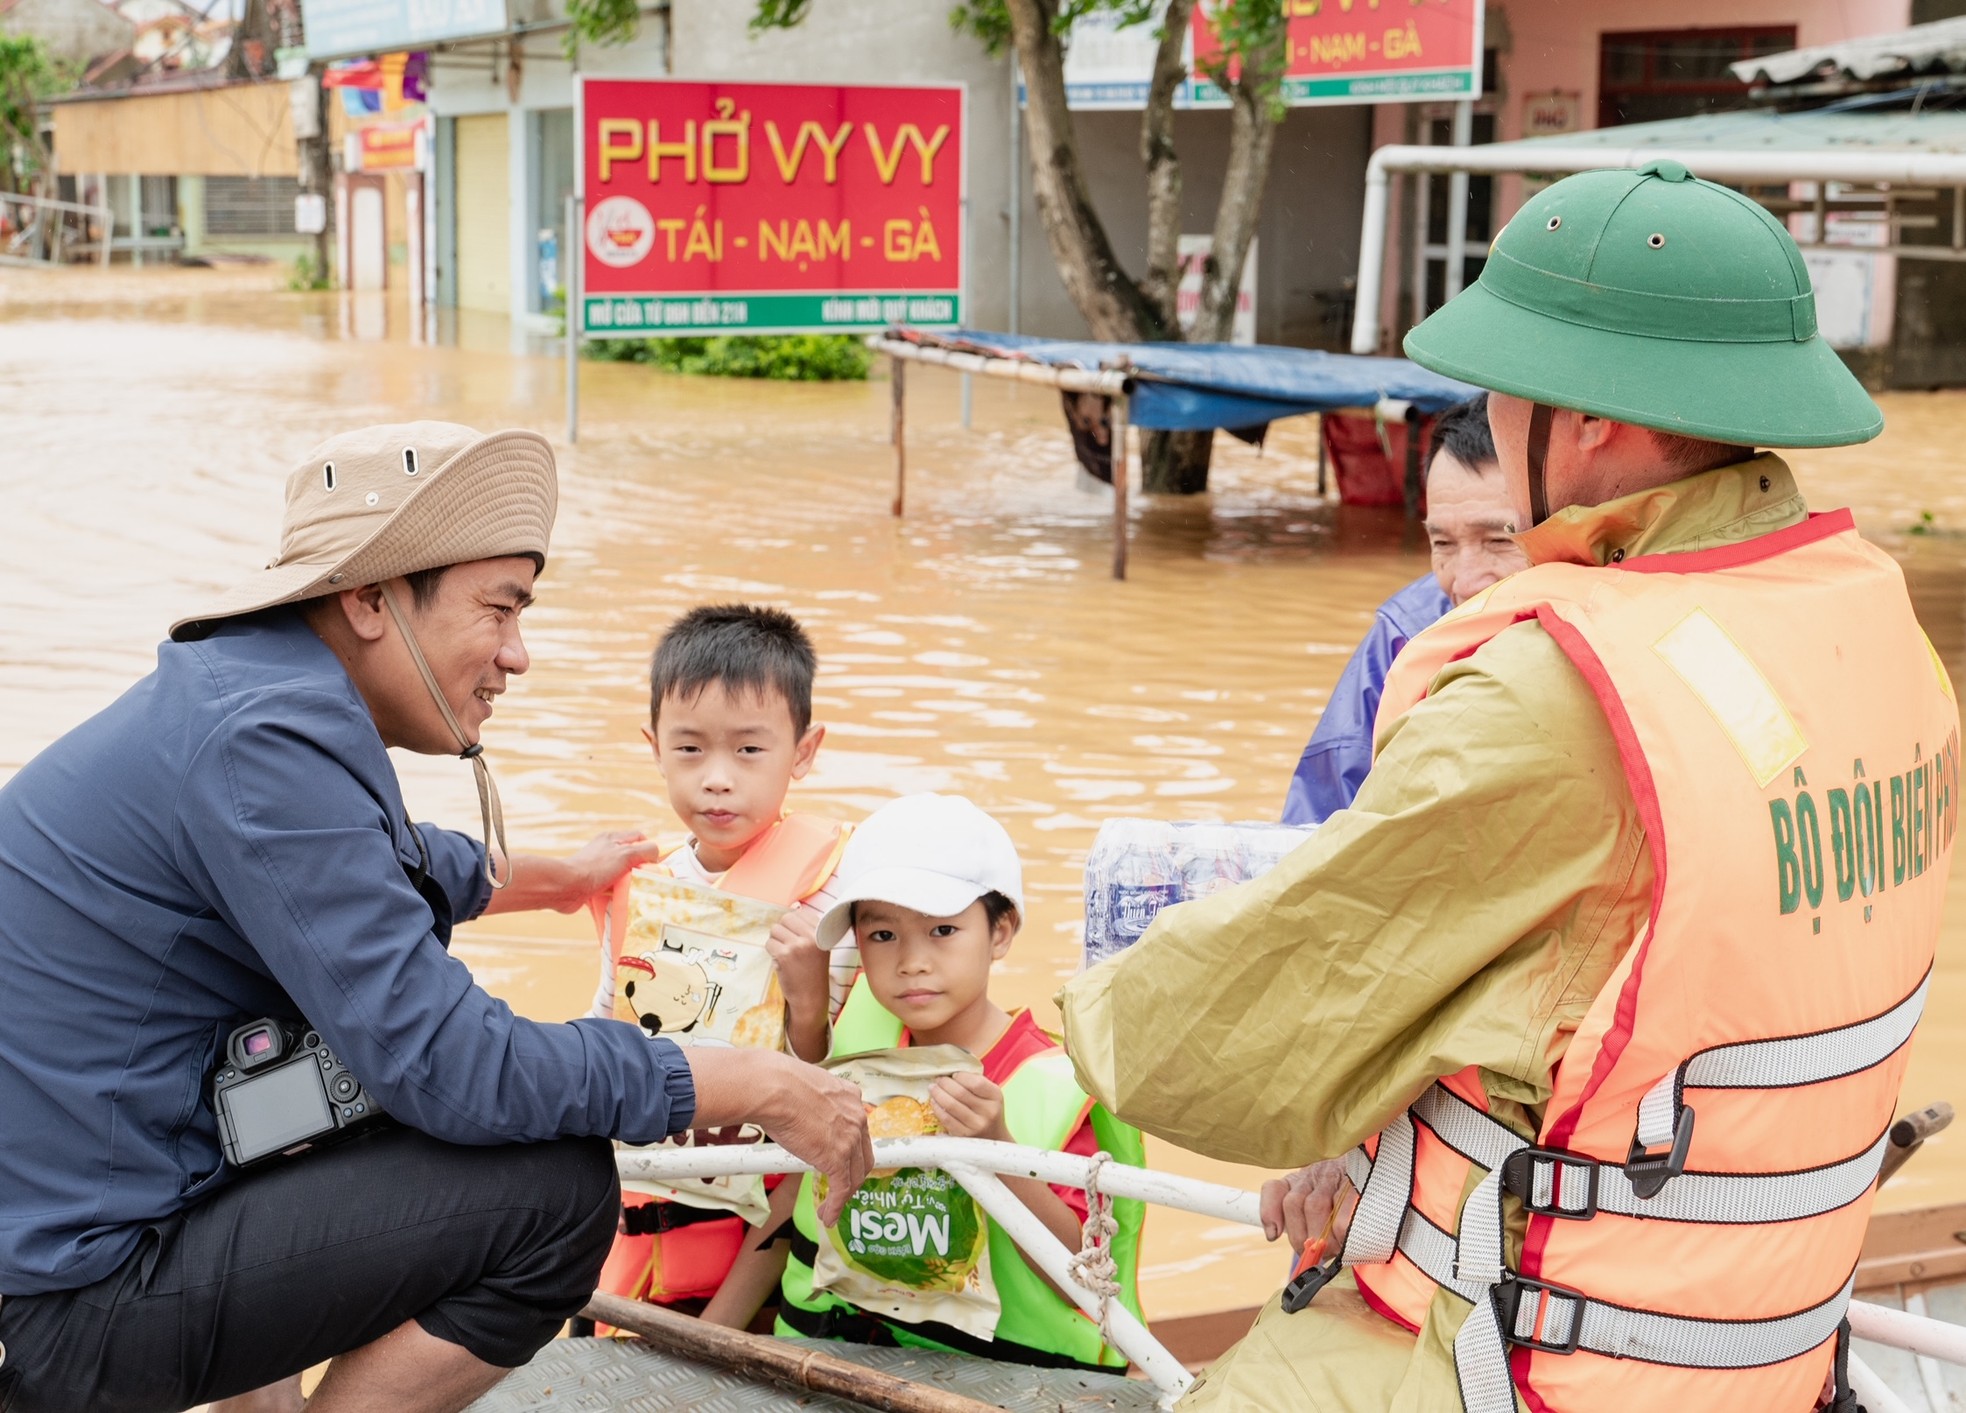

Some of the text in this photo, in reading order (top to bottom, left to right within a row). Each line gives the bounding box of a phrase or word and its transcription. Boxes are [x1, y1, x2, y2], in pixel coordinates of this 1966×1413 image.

[1310, 32, 1366, 69] NẠM
[1383, 18, 1423, 59] GÀ
[598, 97, 951, 185] PHỞ VY VY
[657, 204, 723, 262] TÁI
[759, 219, 851, 272] NẠM
[884, 206, 941, 262] GÀ
[1768, 766, 1824, 935] BỘ
[1827, 758, 1885, 924] ĐỘI
[1890, 742, 1933, 887] BIÊN
[901, 1190, 925, 1209] Tự
[850, 1208, 950, 1257] Mesi
